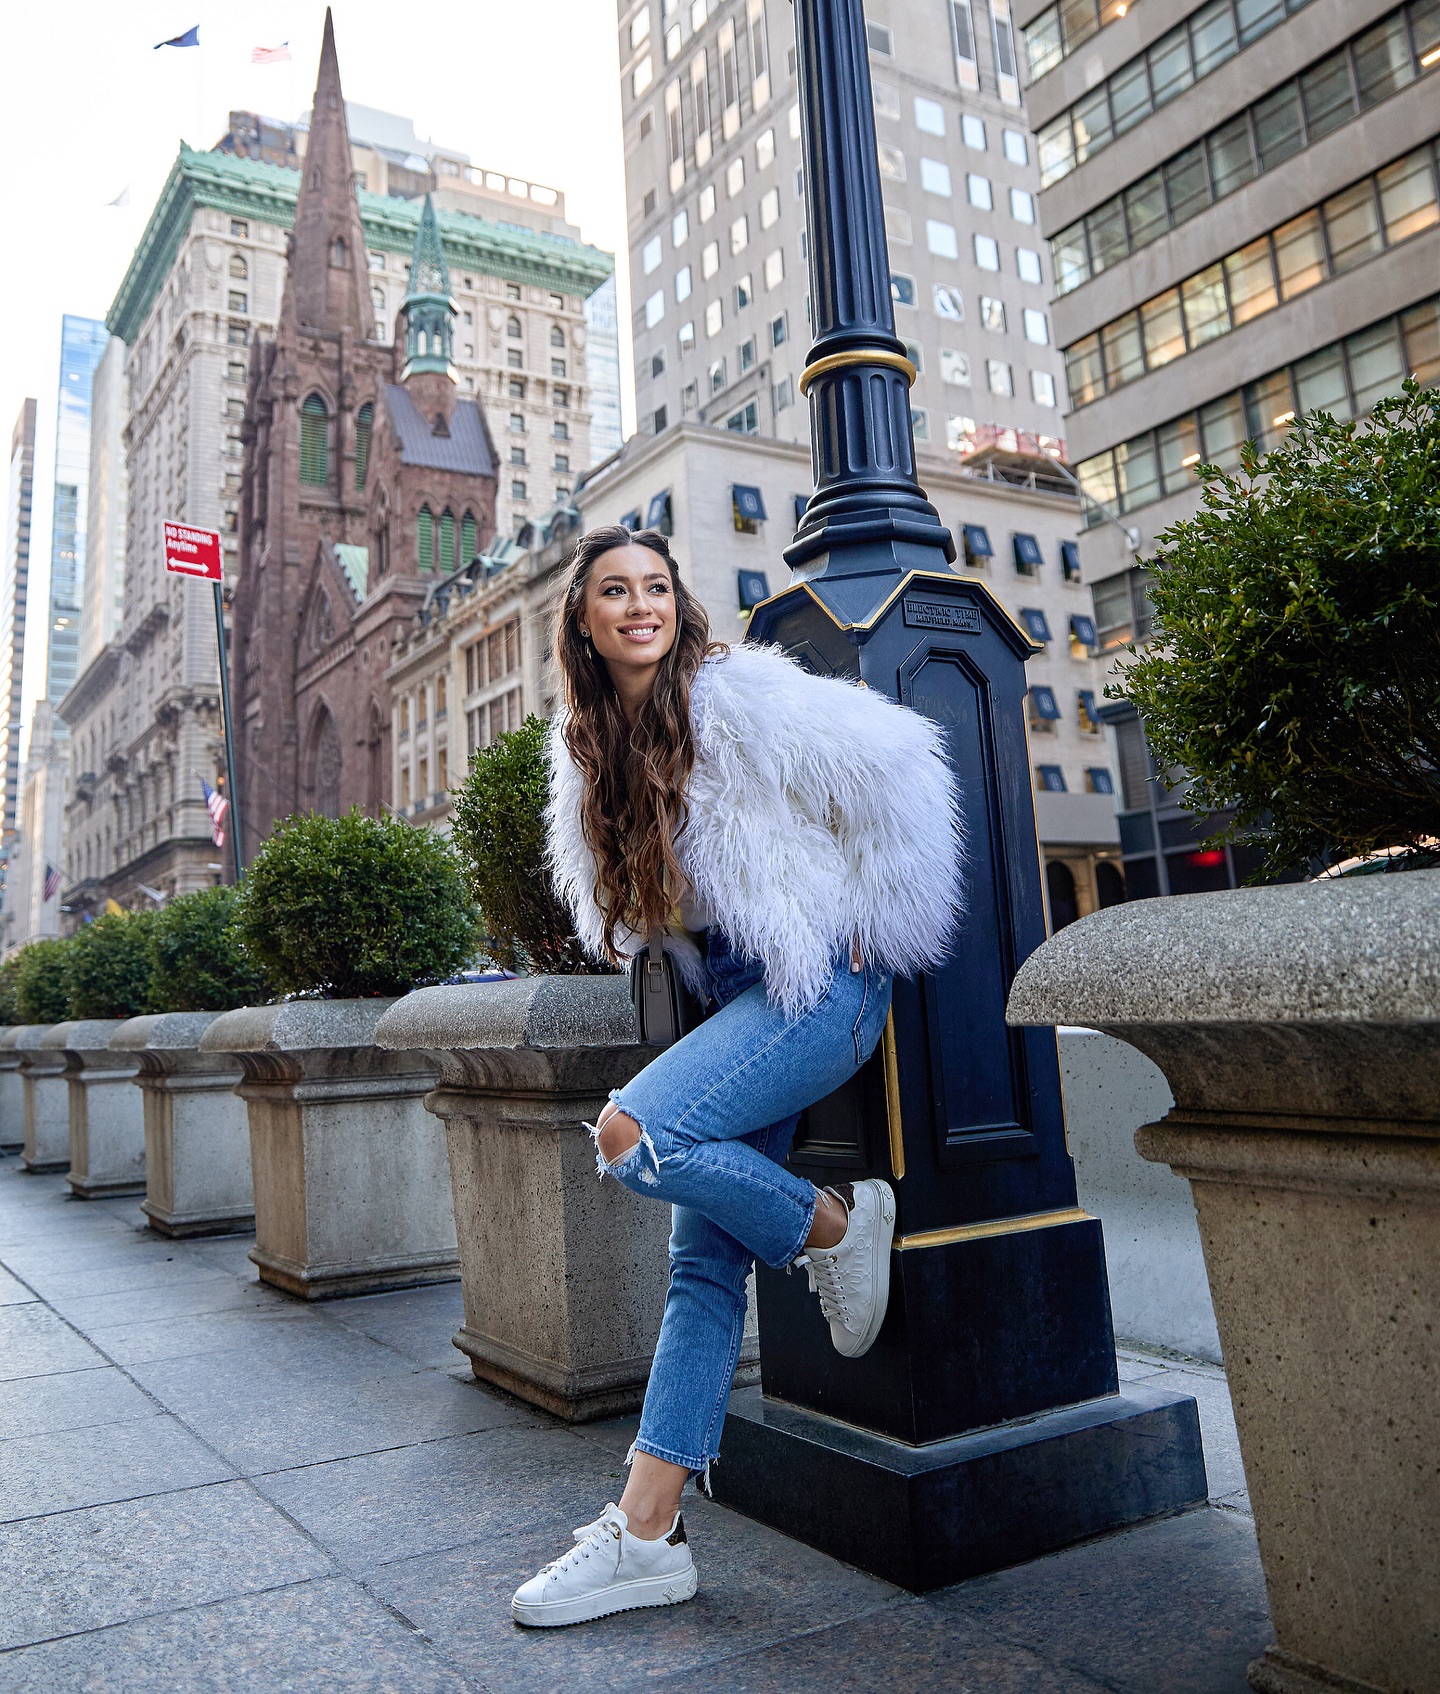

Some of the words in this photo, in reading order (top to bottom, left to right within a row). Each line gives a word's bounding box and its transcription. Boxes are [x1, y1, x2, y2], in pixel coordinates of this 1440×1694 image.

[165, 525, 177, 538] NO
[177, 528, 213, 546] STANDING
[167, 537, 198, 554] Anytime
[907, 603, 951, 617] ELECTRIC
[955, 609, 978, 620] TIME
